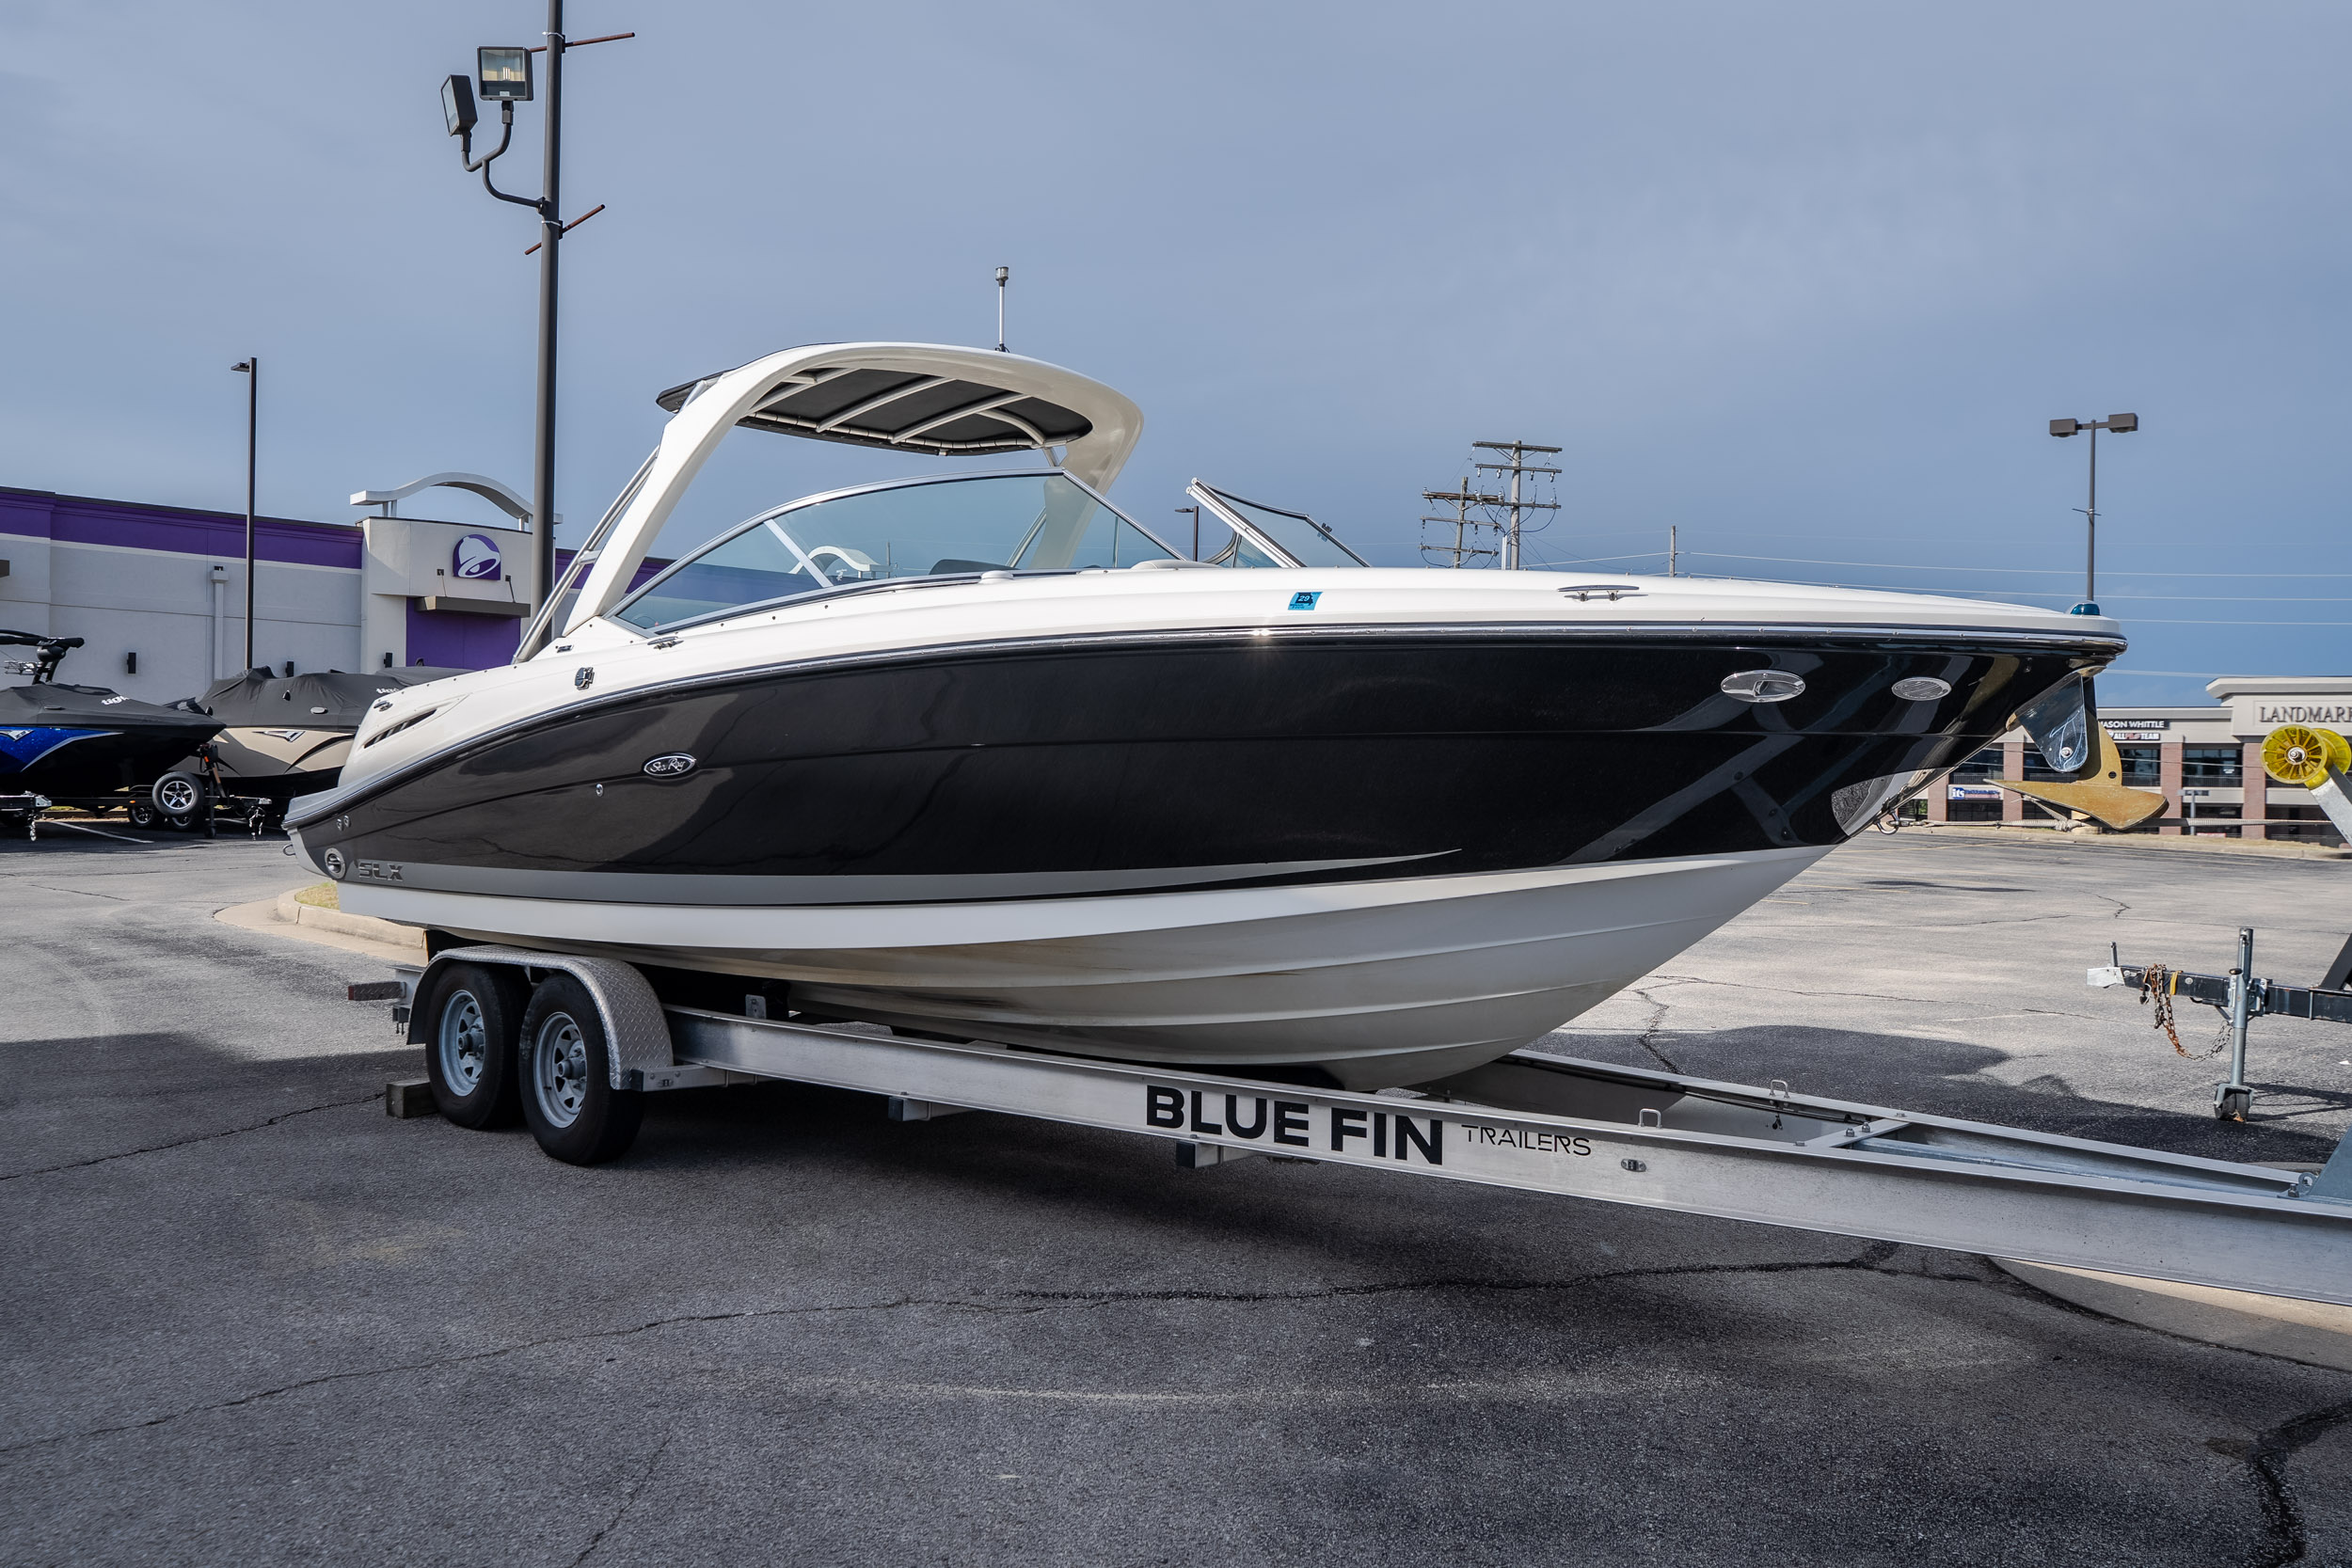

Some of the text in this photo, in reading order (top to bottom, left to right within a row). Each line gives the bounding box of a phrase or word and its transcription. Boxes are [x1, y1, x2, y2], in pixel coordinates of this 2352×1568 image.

[2128, 721, 2165, 729] WHITTLE
[650, 757, 686, 772] Sea Ray
[358, 861, 405, 882] SLX
[1146, 1085, 1592, 1165] BLUE FIN TRAILERS
